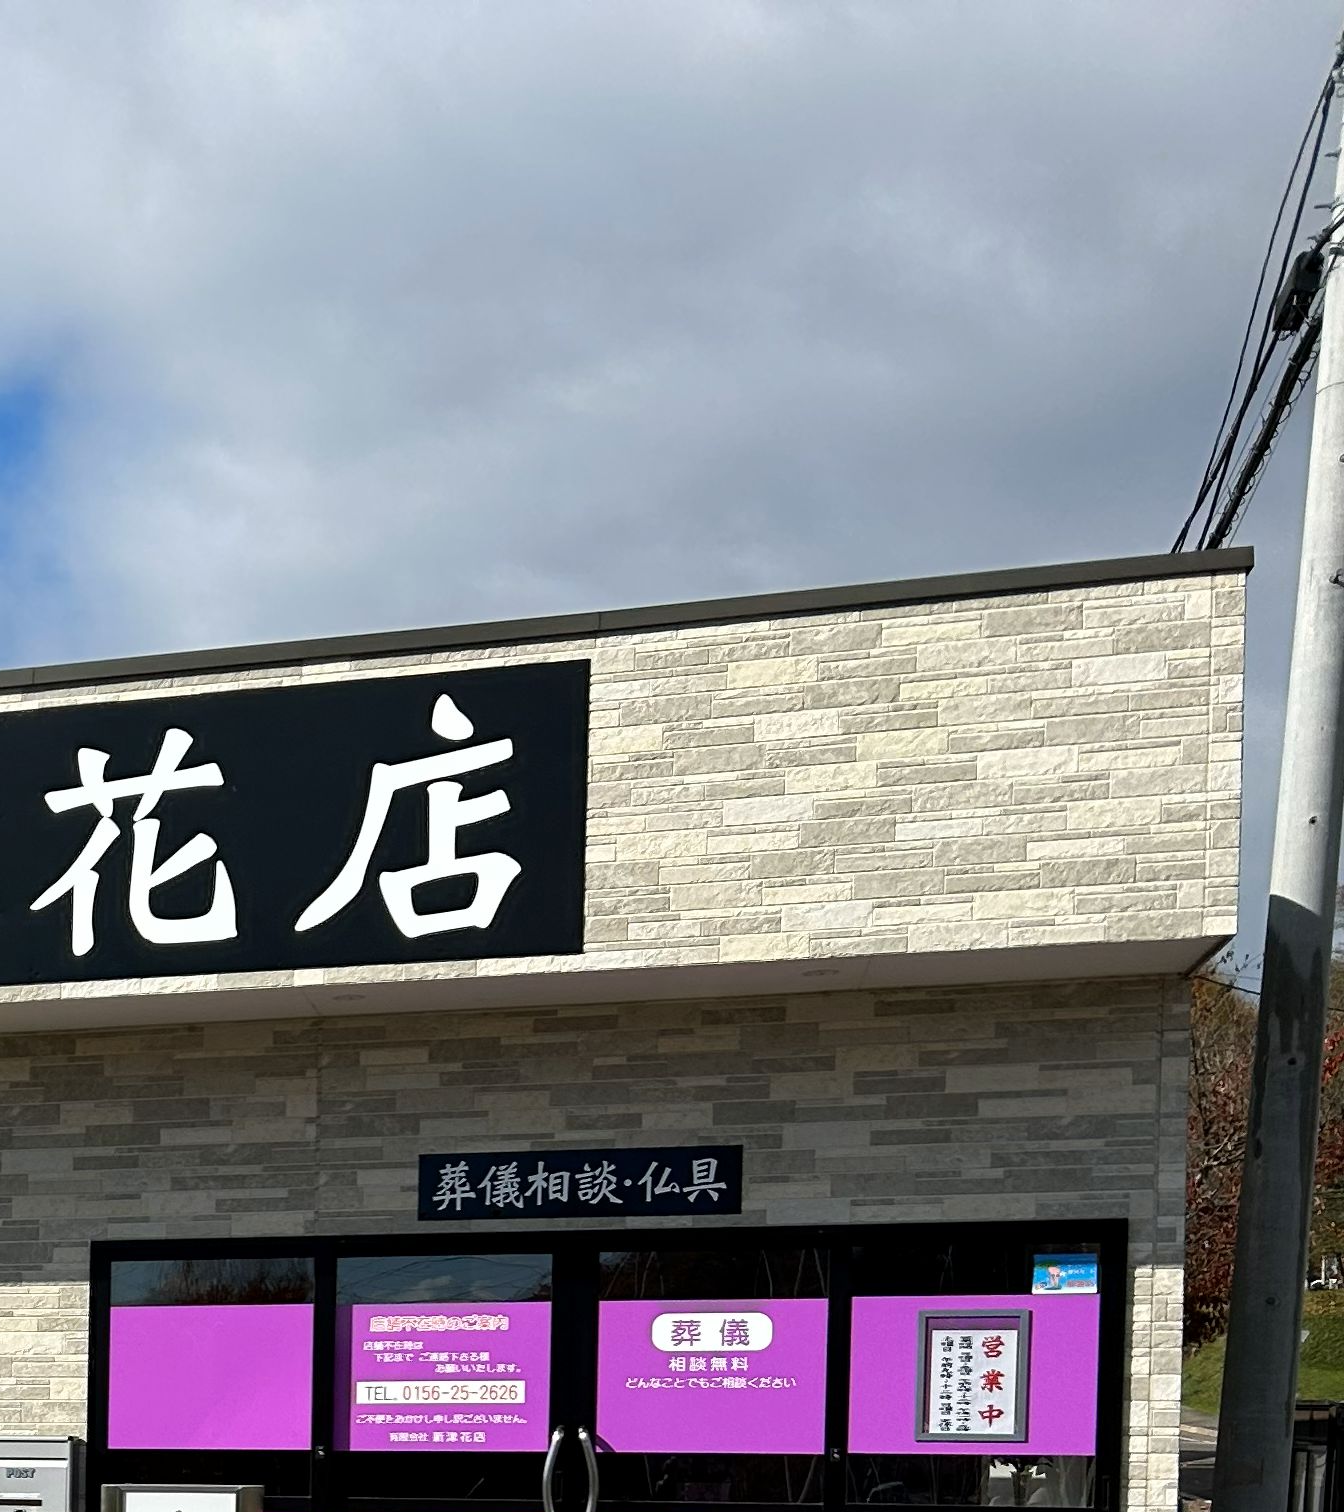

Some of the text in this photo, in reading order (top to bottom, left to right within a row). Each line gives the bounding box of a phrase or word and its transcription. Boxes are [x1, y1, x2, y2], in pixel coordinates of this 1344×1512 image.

[432, 1157, 727, 1211] 葬儀相談・仏具
[670, 1318, 750, 1347] 葬儀
[668, 1357, 749, 1371] 相談無料
[625, 1376, 797, 1389] どんなことでもご相談ください
[977, 1335, 1006, 1428] 営業中
[365, 1385, 519, 1401] TEL. 0156-25-2626
[5, 1467, 36, 1478] POST
